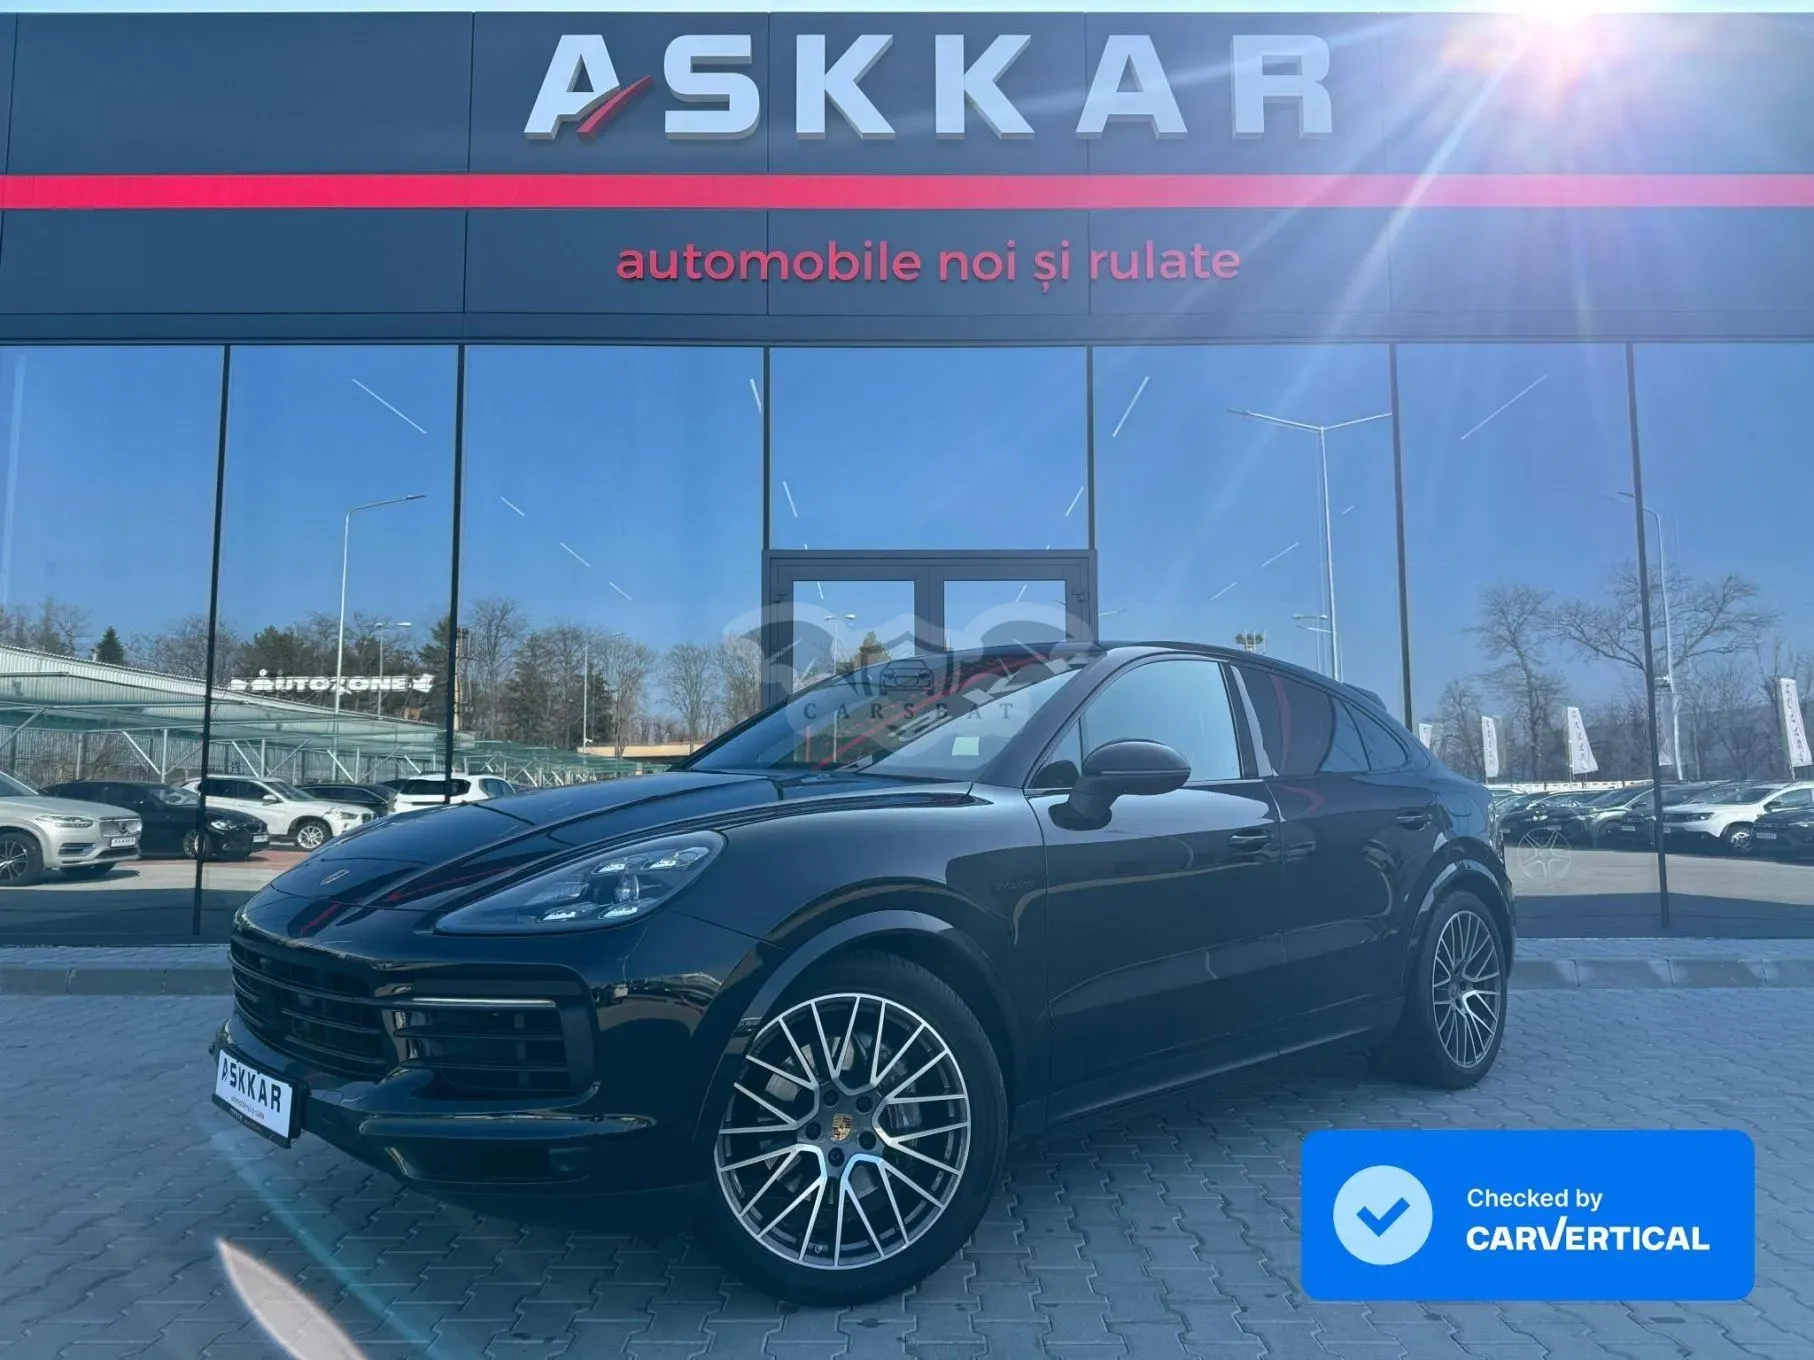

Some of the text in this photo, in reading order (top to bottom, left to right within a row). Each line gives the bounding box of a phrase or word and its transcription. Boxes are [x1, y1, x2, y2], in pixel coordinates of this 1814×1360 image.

[524, 34, 1333, 140] ASKKAR
[616, 240, 1242, 293] automobile noi și rulate
[221, 1057, 282, 1113] ASKKAR
